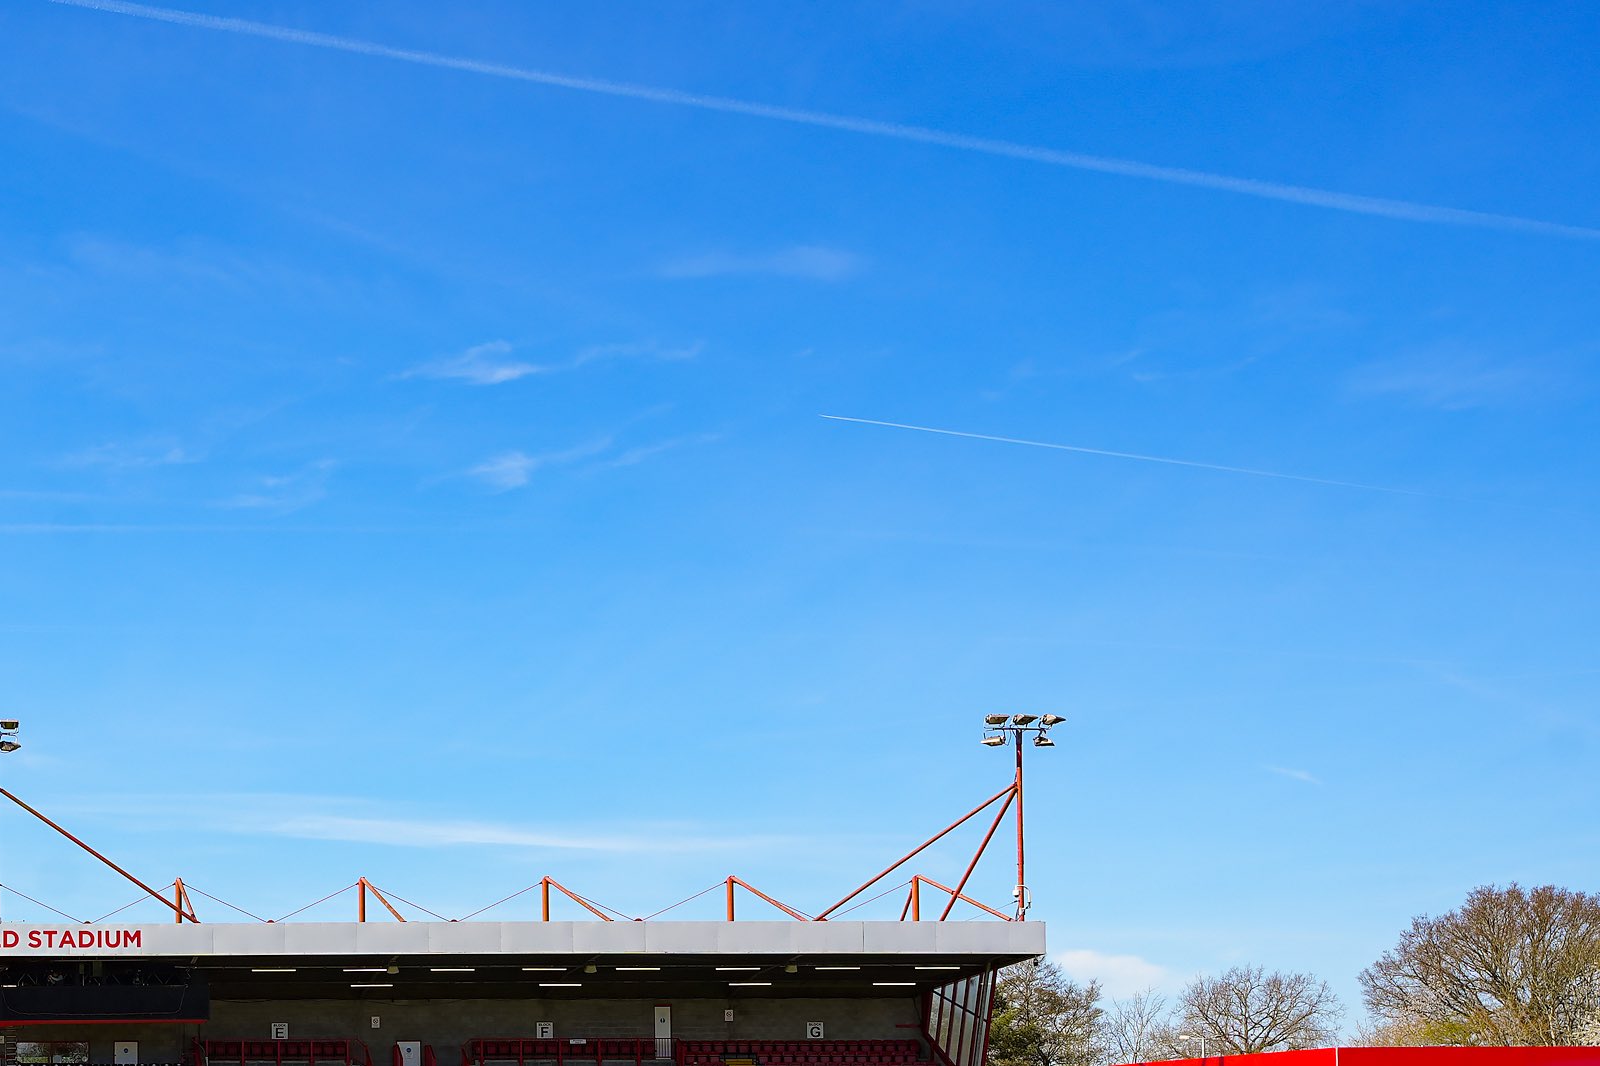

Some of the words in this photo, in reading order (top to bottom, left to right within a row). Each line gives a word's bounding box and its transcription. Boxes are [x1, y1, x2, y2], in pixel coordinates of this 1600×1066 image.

[27, 930, 142, 949] STADIUM
[276, 1028, 285, 1038] E
[540, 1027, 549, 1038] F
[810, 1027, 821, 1038] G
